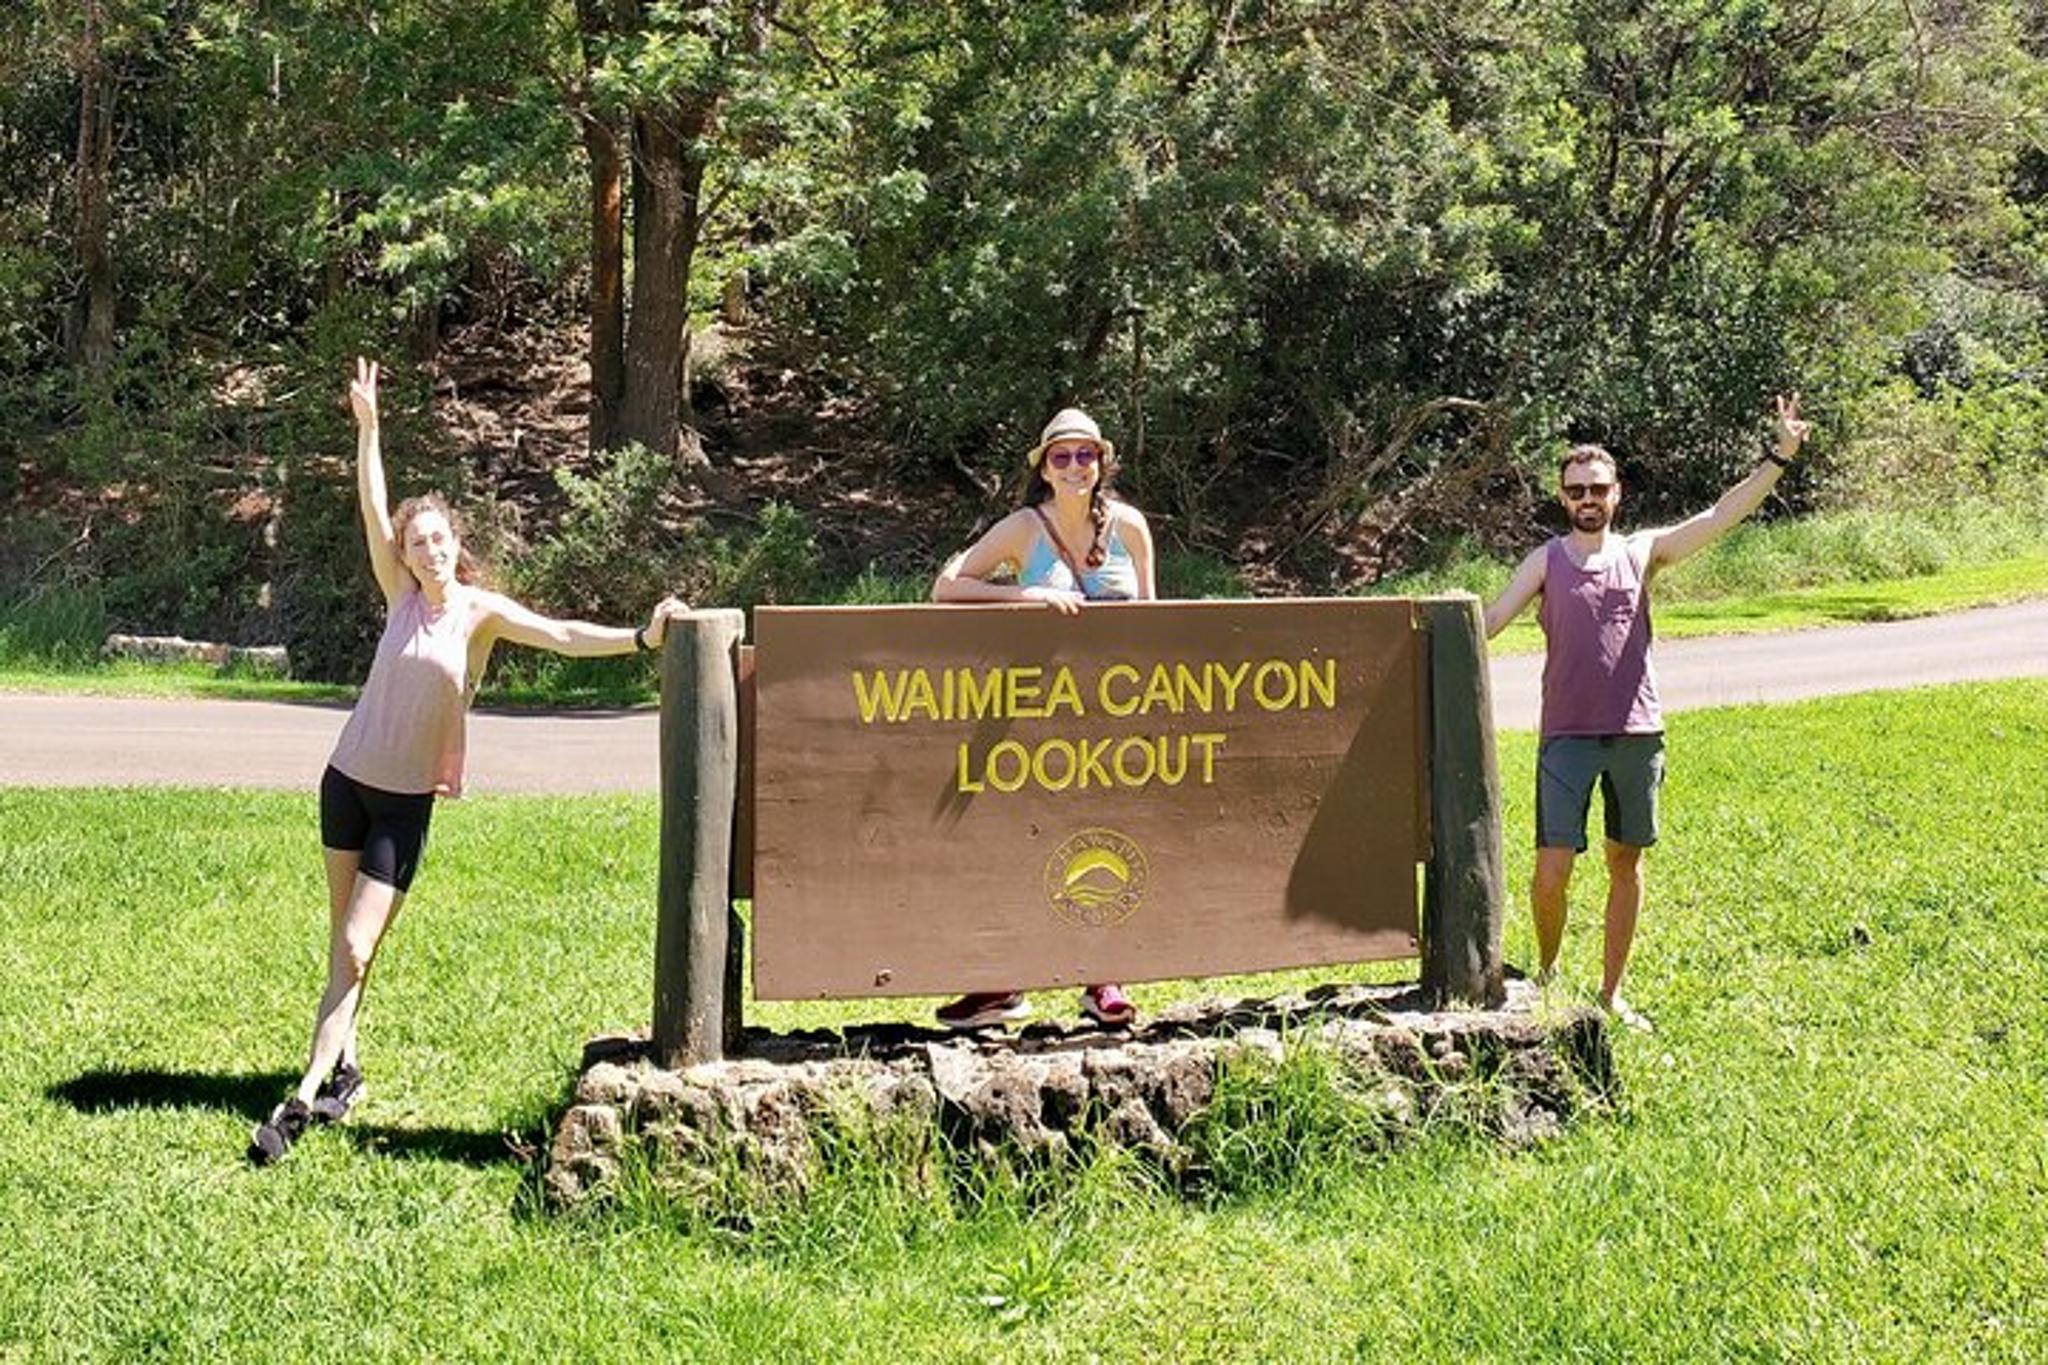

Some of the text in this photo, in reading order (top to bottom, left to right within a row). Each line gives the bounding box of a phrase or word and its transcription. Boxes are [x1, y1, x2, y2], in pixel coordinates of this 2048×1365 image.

[854, 660, 1336, 722] WAIMEA CANYON
[959, 734, 1226, 793] LOOKOUT
